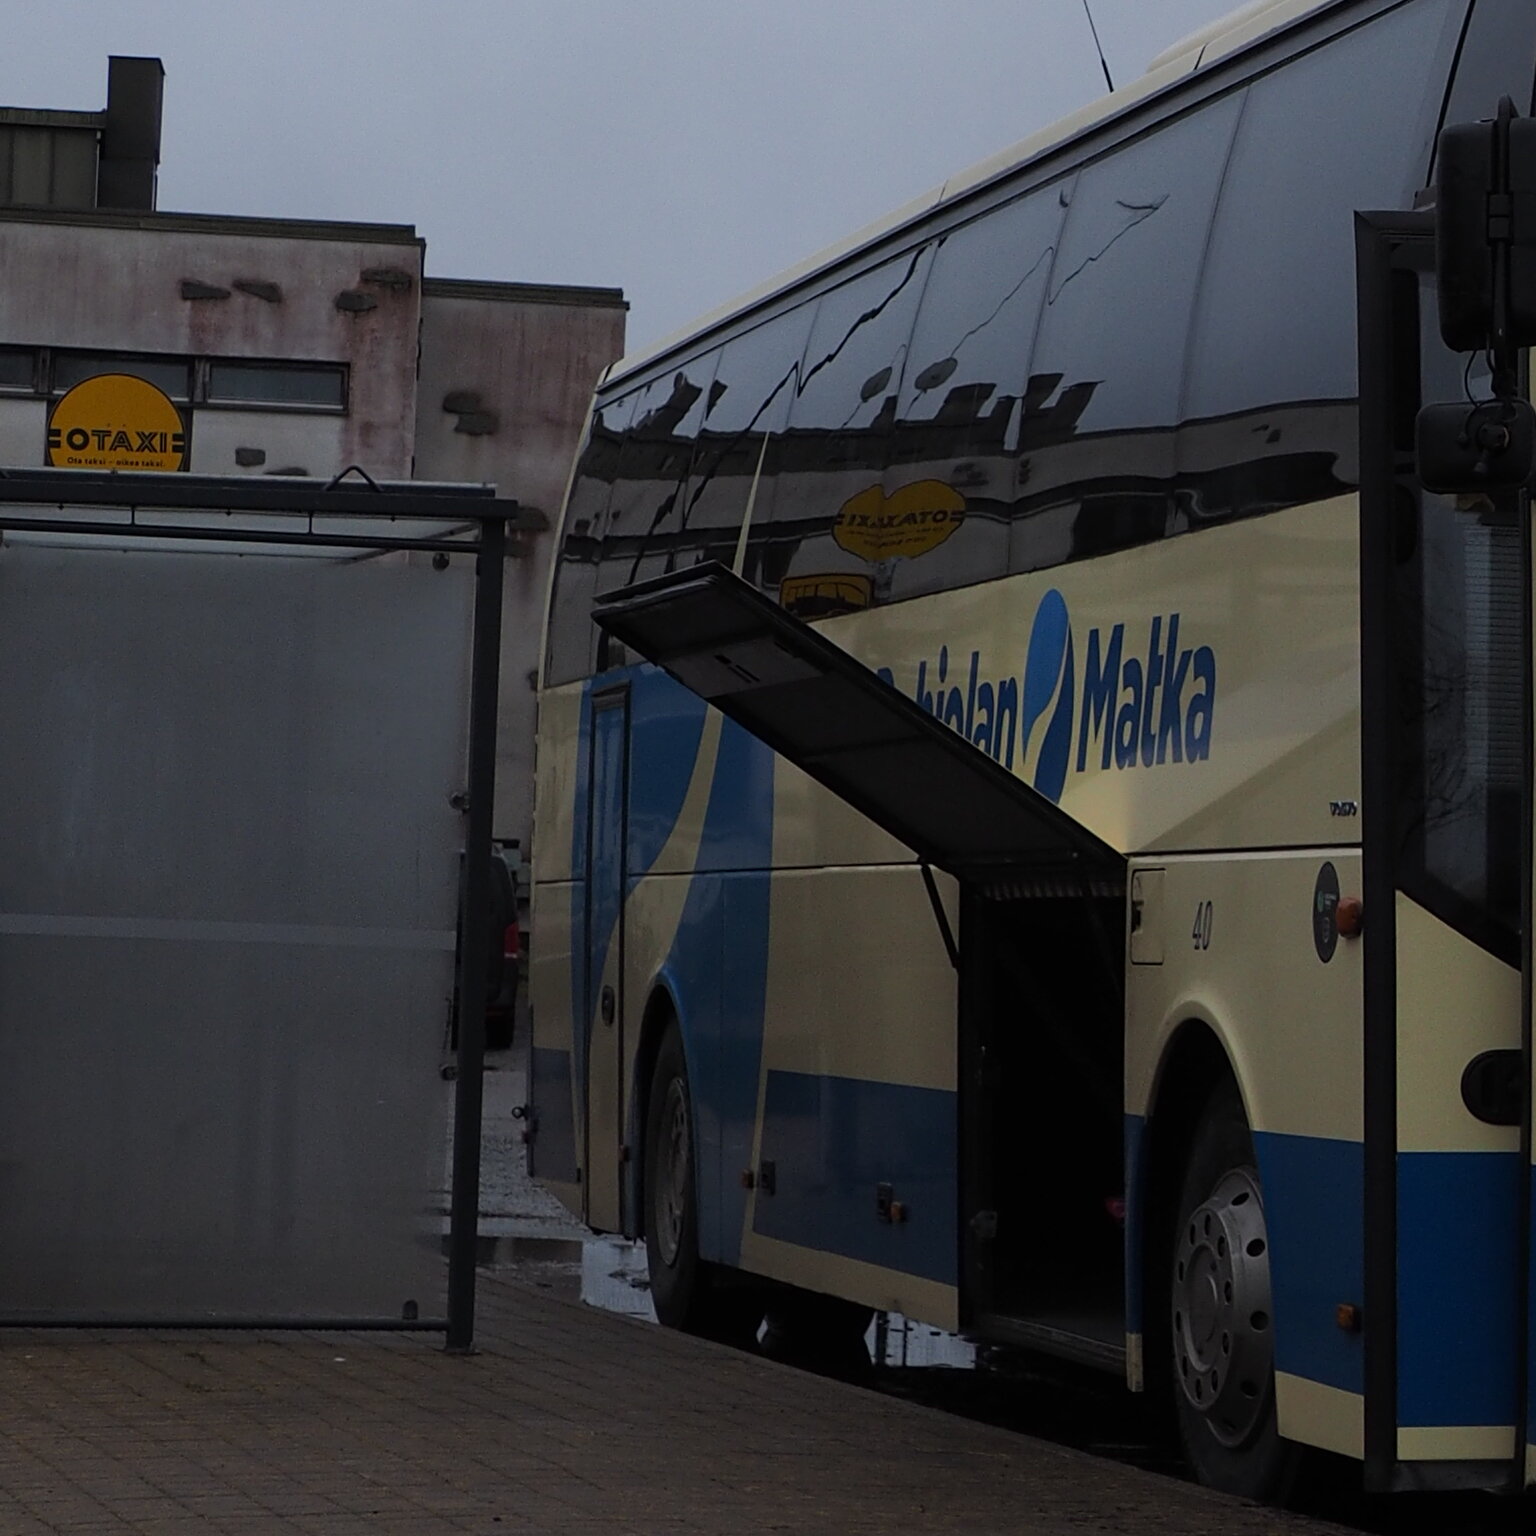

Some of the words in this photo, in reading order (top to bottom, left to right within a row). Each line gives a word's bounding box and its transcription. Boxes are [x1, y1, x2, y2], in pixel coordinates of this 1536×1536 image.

[66, 428, 167, 453] OTAXI
[1076, 613, 1216, 773] Matka
[1192, 900, 1213, 950] 40
